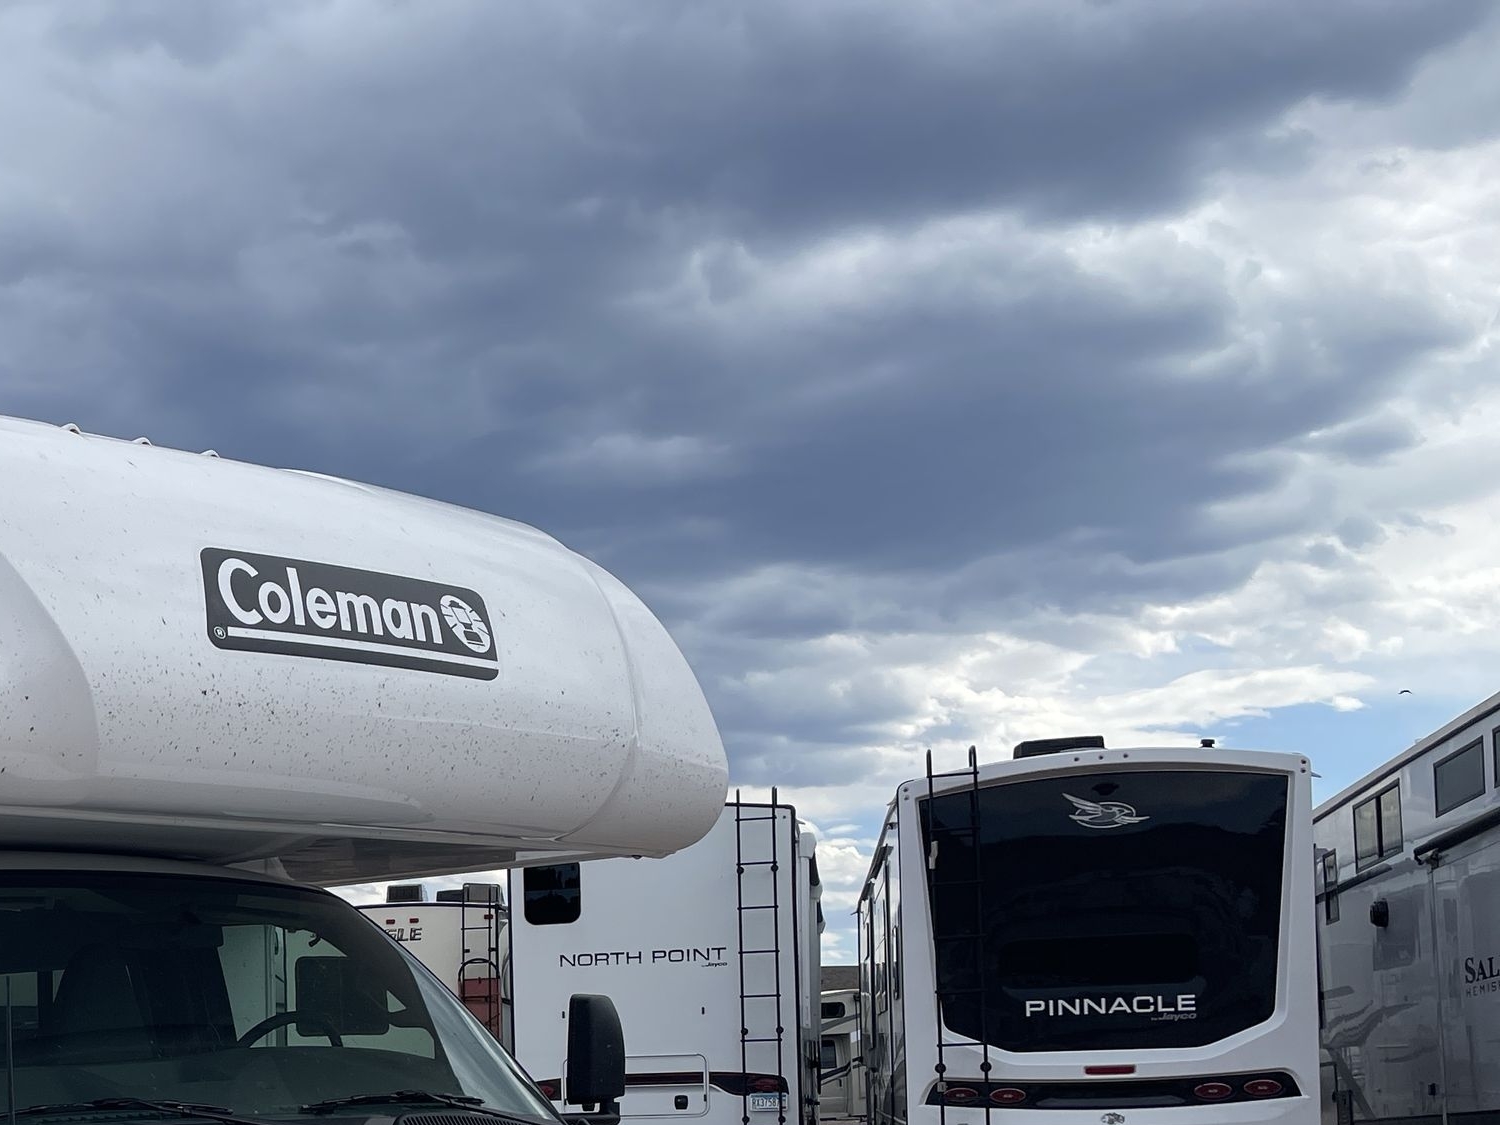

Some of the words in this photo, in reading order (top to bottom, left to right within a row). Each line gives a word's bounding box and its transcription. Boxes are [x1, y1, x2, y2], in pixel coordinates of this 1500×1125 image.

[217, 557, 444, 645] Coleman
[559, 951, 642, 967] NORTH
[651, 947, 727, 964] POINT
[1464, 956, 1500, 984] SAL
[1025, 994, 1197, 1017] PINNACLE
[1158, 1012, 1197, 1022] Jayco
